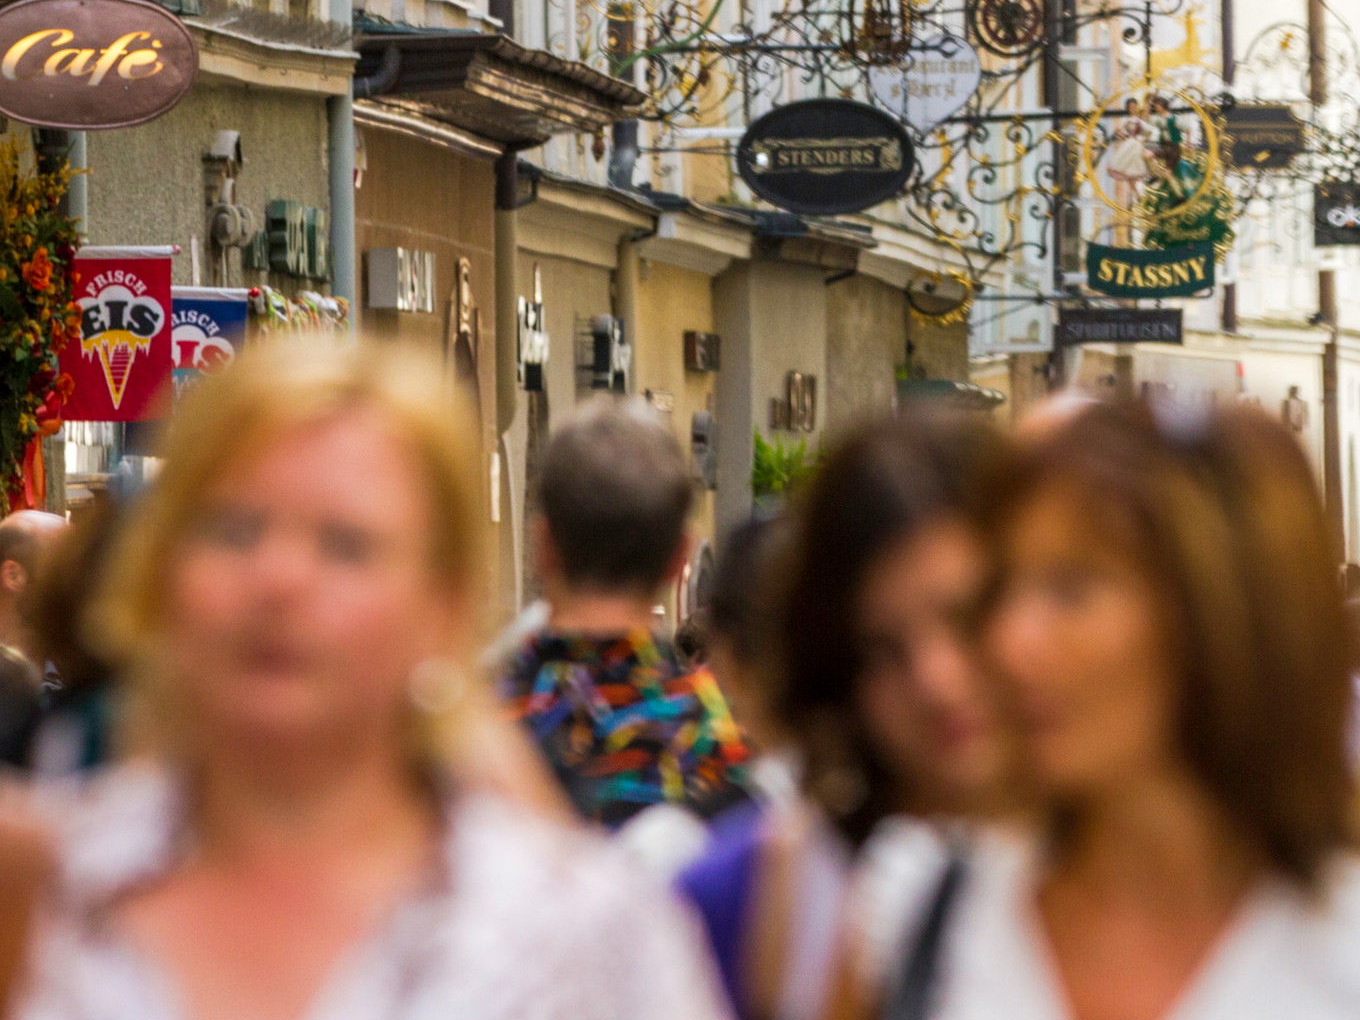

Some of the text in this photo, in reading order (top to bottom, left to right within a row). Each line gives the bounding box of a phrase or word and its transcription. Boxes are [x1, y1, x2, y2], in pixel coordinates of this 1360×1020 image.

[2, 28, 163, 87] Café
[777, 148, 875, 166] STENDERS
[85, 269, 148, 298] FRISCH
[1097, 255, 1207, 288] STASSNY
[80, 300, 160, 341] EIS
